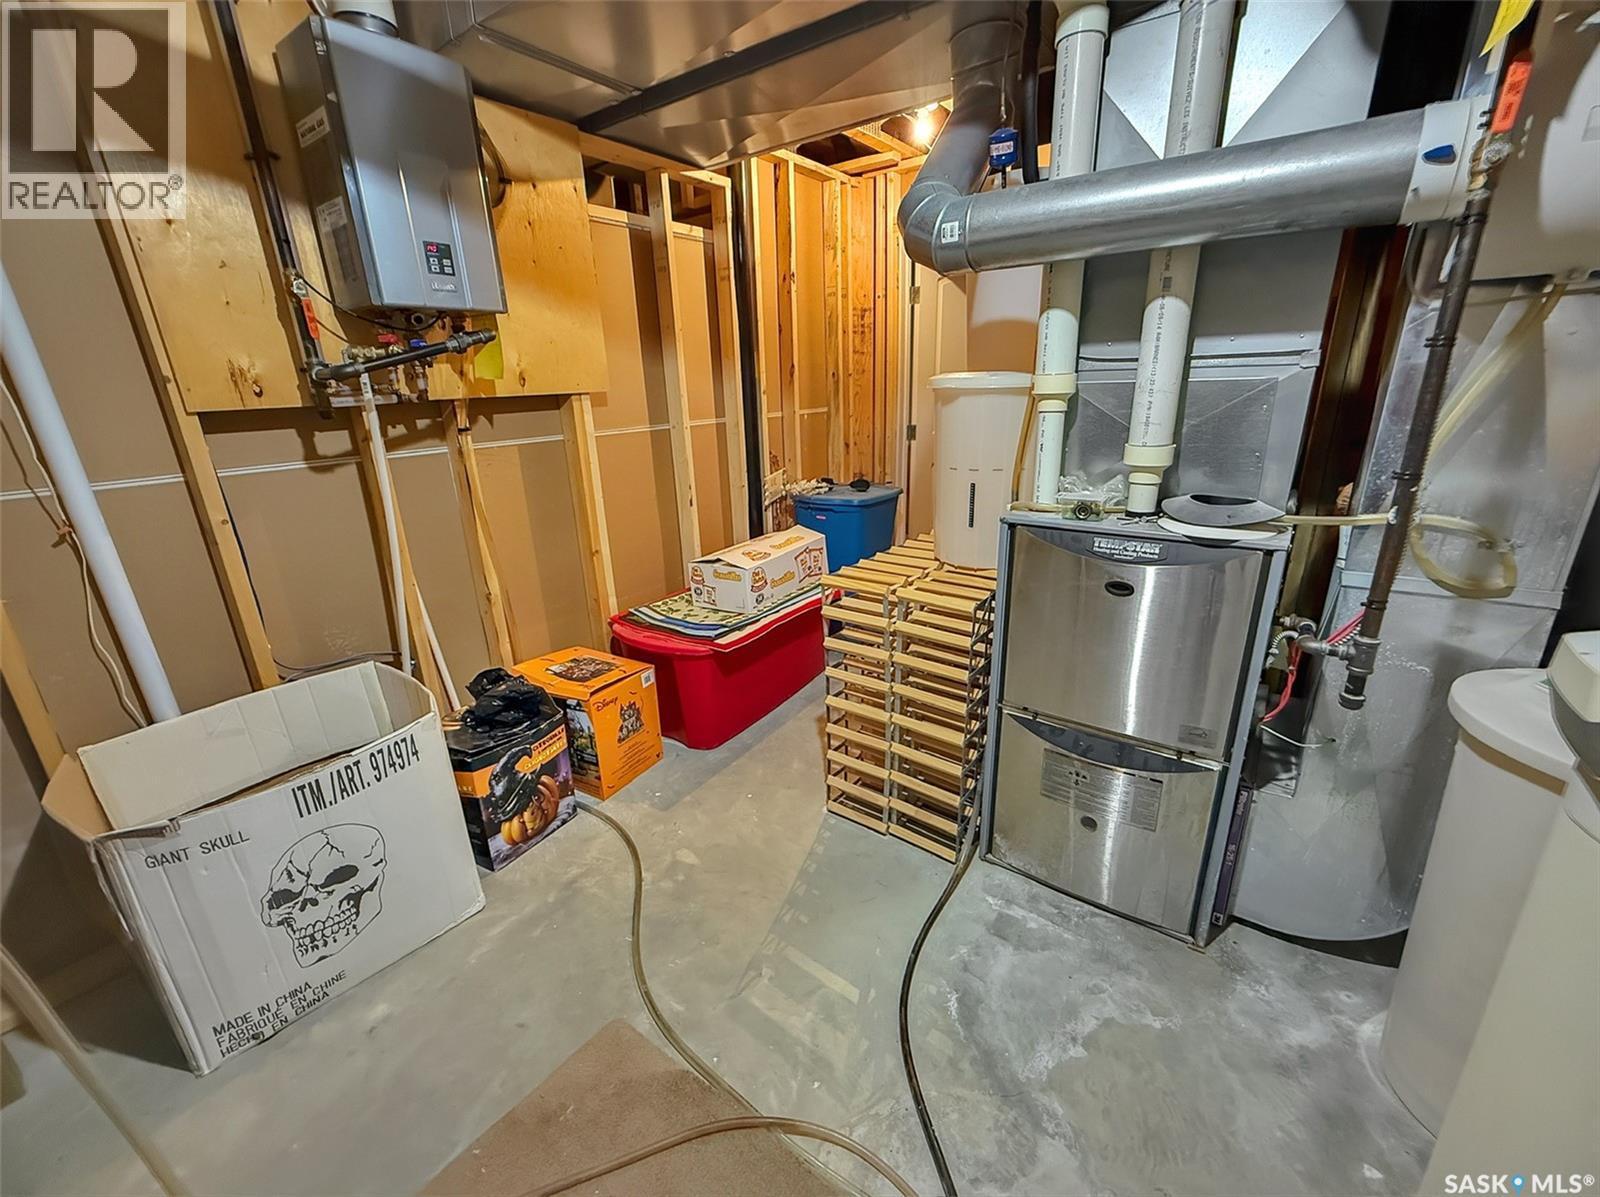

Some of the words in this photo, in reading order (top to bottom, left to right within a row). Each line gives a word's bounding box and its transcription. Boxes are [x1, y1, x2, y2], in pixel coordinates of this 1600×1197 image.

[592, 696, 618, 712] Disney
[291, 760, 371, 818] ITM./ART.
[369, 733, 420, 783] 974974
[144, 847, 190, 869] GIANT
[199, 831, 250, 855] SKULL
[212, 1011, 255, 1037] MADE
[257, 1003, 271, 1017] IN
[275, 981, 313, 1008] CHINA
[290, 994, 307, 1009] EN
[312, 969, 347, 996] CHINE
[272, 1015, 289, 1032] EN
[294, 991, 330, 1016] CHINA
